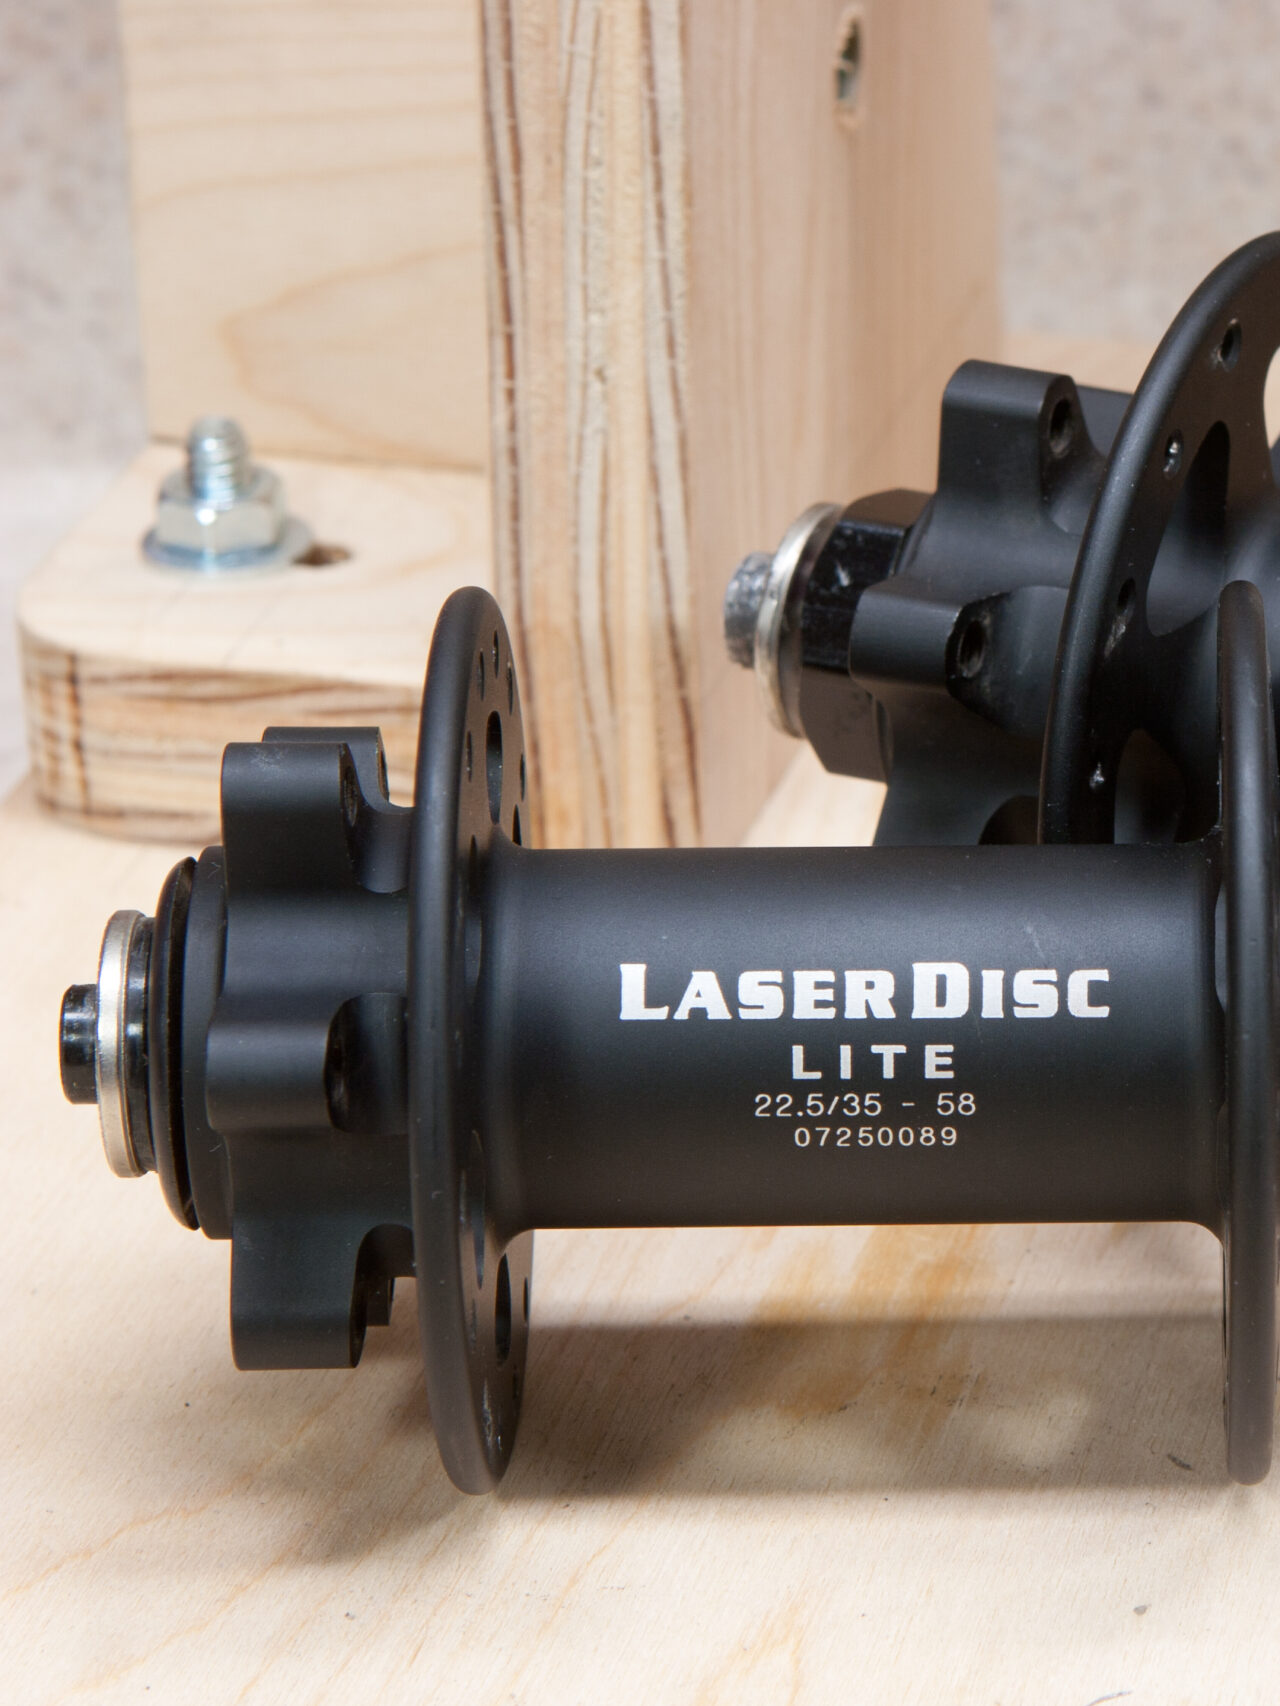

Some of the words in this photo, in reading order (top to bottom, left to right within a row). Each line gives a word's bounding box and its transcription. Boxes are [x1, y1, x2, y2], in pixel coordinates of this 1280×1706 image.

[792, 1044, 955, 1080] LITE
[754, 1093, 882, 1117] 22.5/35
[936, 1092, 977, 1116] 58
[794, 1127, 957, 1147] 07250089
